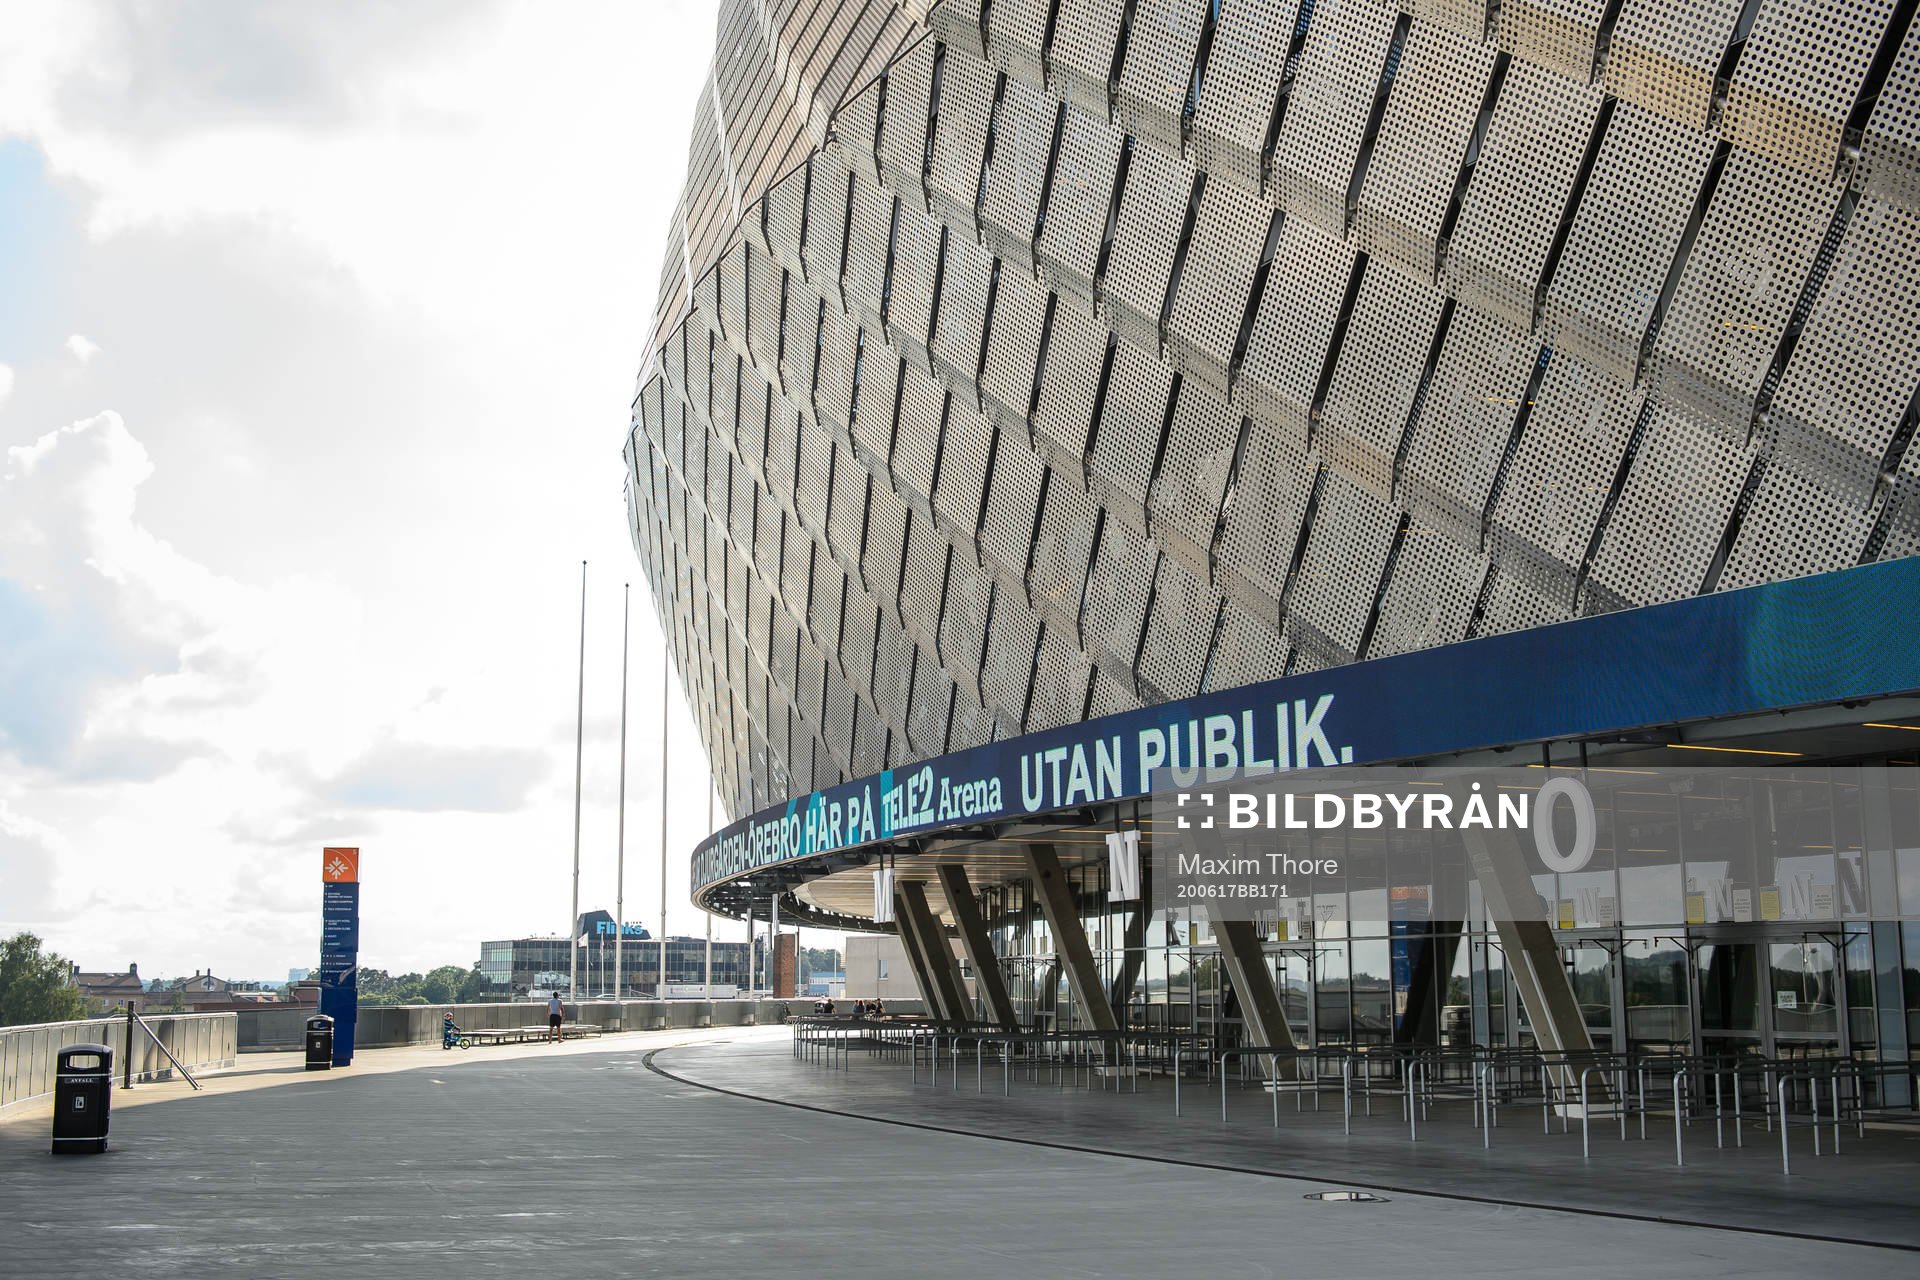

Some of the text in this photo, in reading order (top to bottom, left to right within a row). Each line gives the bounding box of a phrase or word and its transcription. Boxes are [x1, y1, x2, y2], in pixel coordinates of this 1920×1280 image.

[805, 796, 843, 854] HÄR
[848, 784, 876, 845] PÅ
[883, 765, 934, 832] TELE2
[938, 776, 1003, 821] Arena
[1021, 735, 1122, 813] UTAN
[1139, 693, 1353, 794] PUBLIK.
[873, 868, 895, 923] M
[1105, 830, 1141, 902] N
